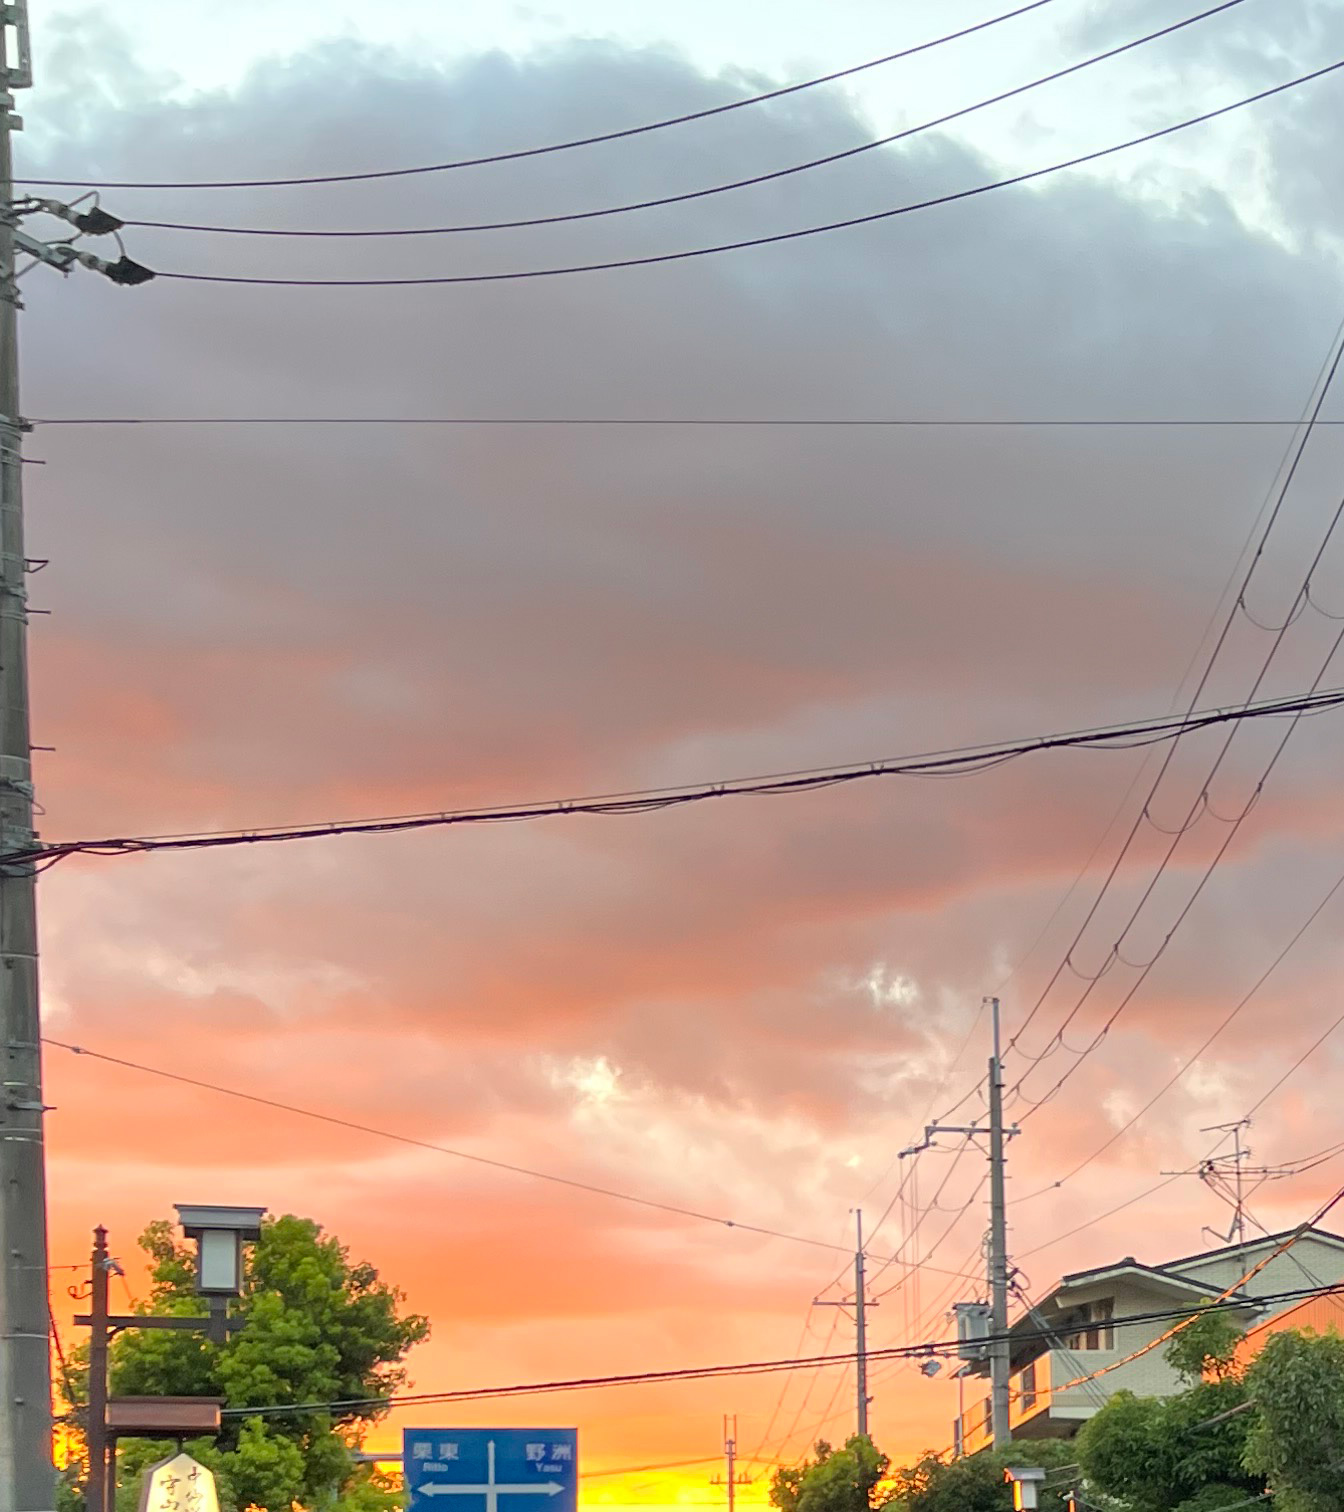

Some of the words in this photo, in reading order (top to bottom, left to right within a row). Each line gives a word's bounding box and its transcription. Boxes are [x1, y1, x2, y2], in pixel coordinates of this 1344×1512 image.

[413, 1442, 459, 1461] 栗東
[525, 1443, 572, 1461] 野洲
[536, 1463, 562, 1473] Yasu
